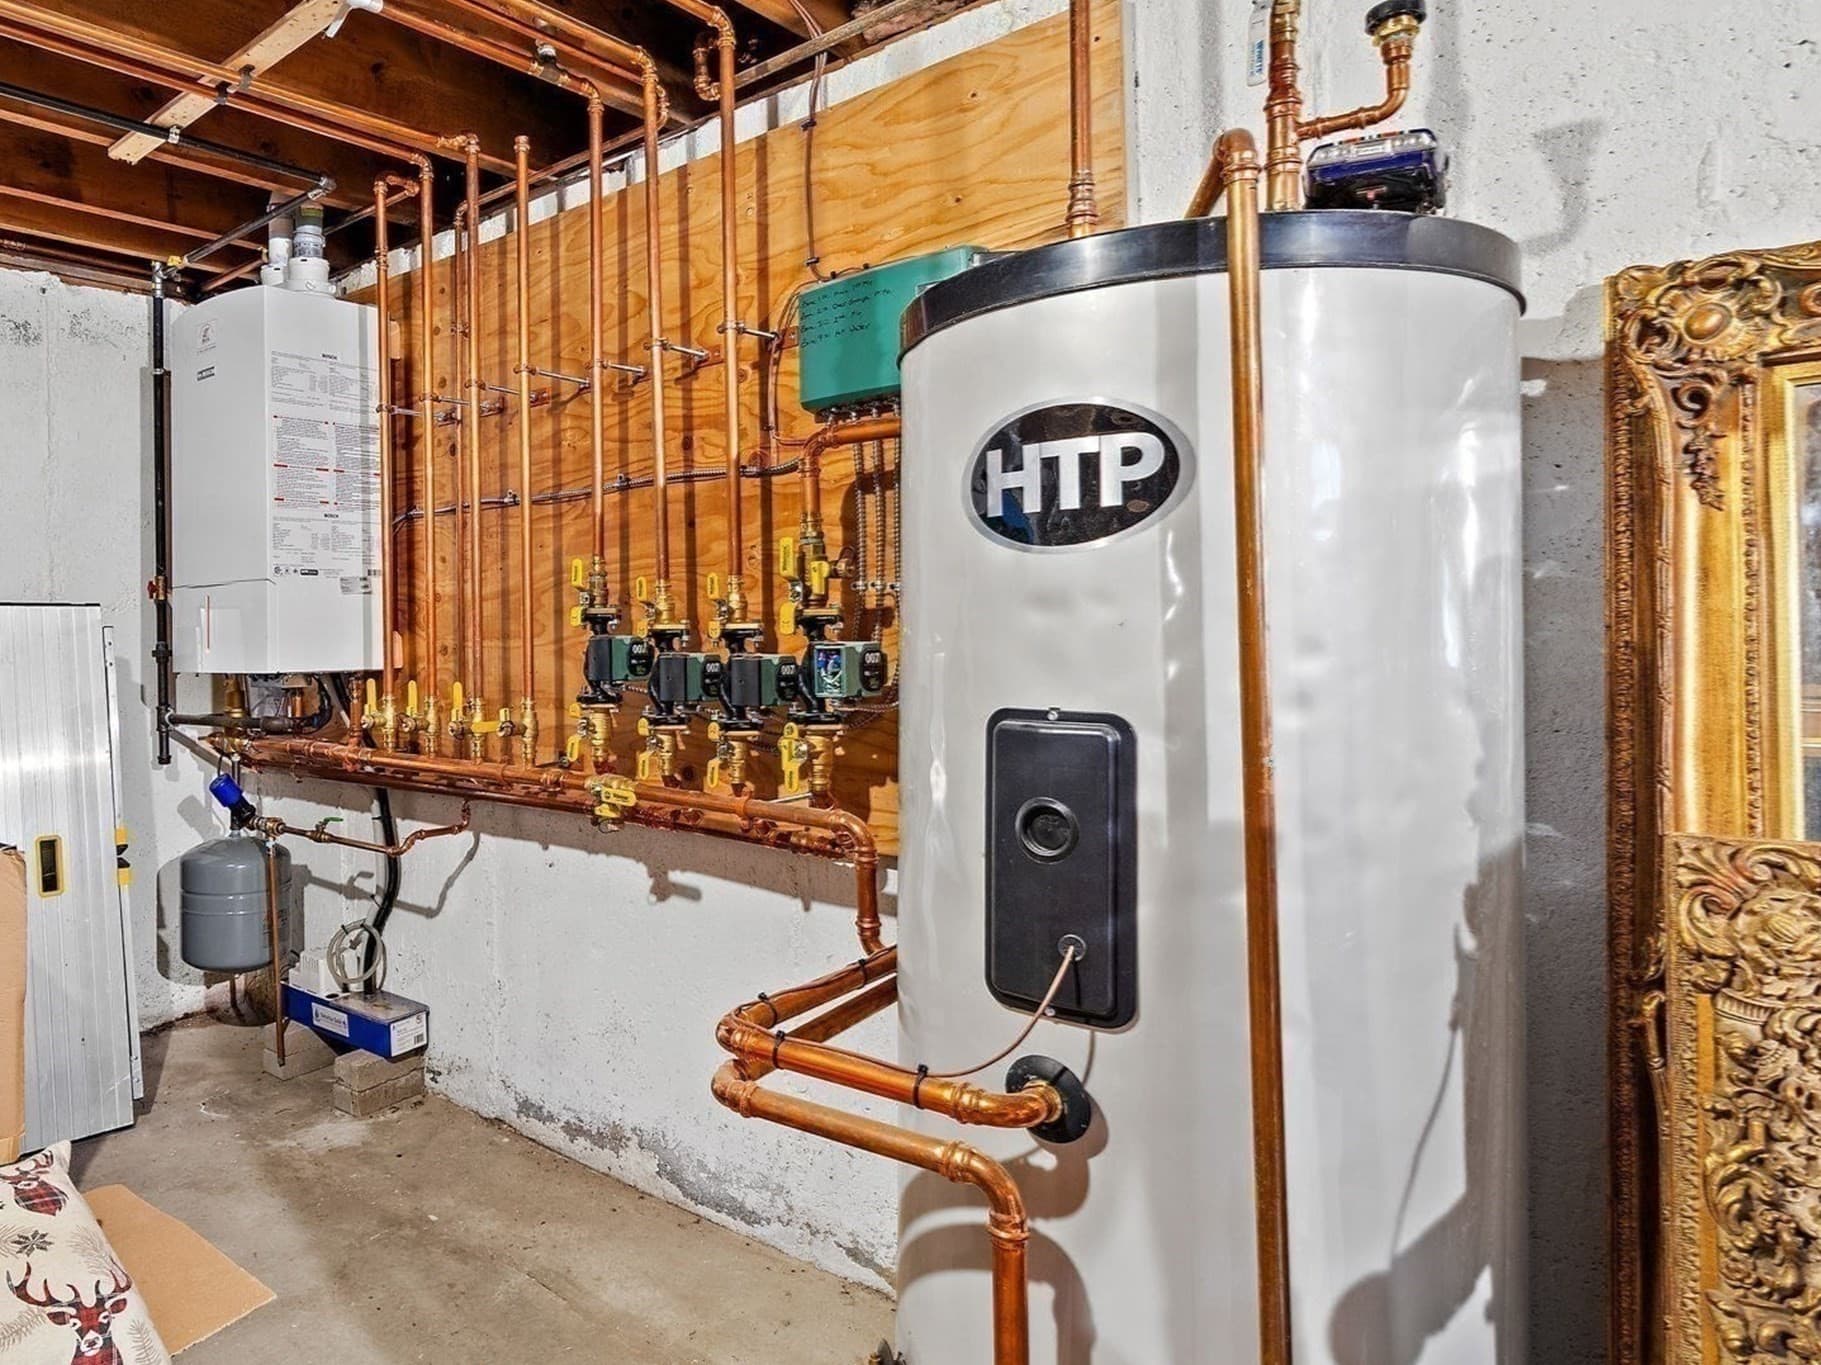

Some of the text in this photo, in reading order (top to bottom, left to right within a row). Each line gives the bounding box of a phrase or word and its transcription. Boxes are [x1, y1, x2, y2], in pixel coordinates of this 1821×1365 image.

[986, 431, 1166, 519] HTP
[865, 653, 880, 663] 007
[706, 663, 720, 673] 007
[781, 664, 796, 675] 007
